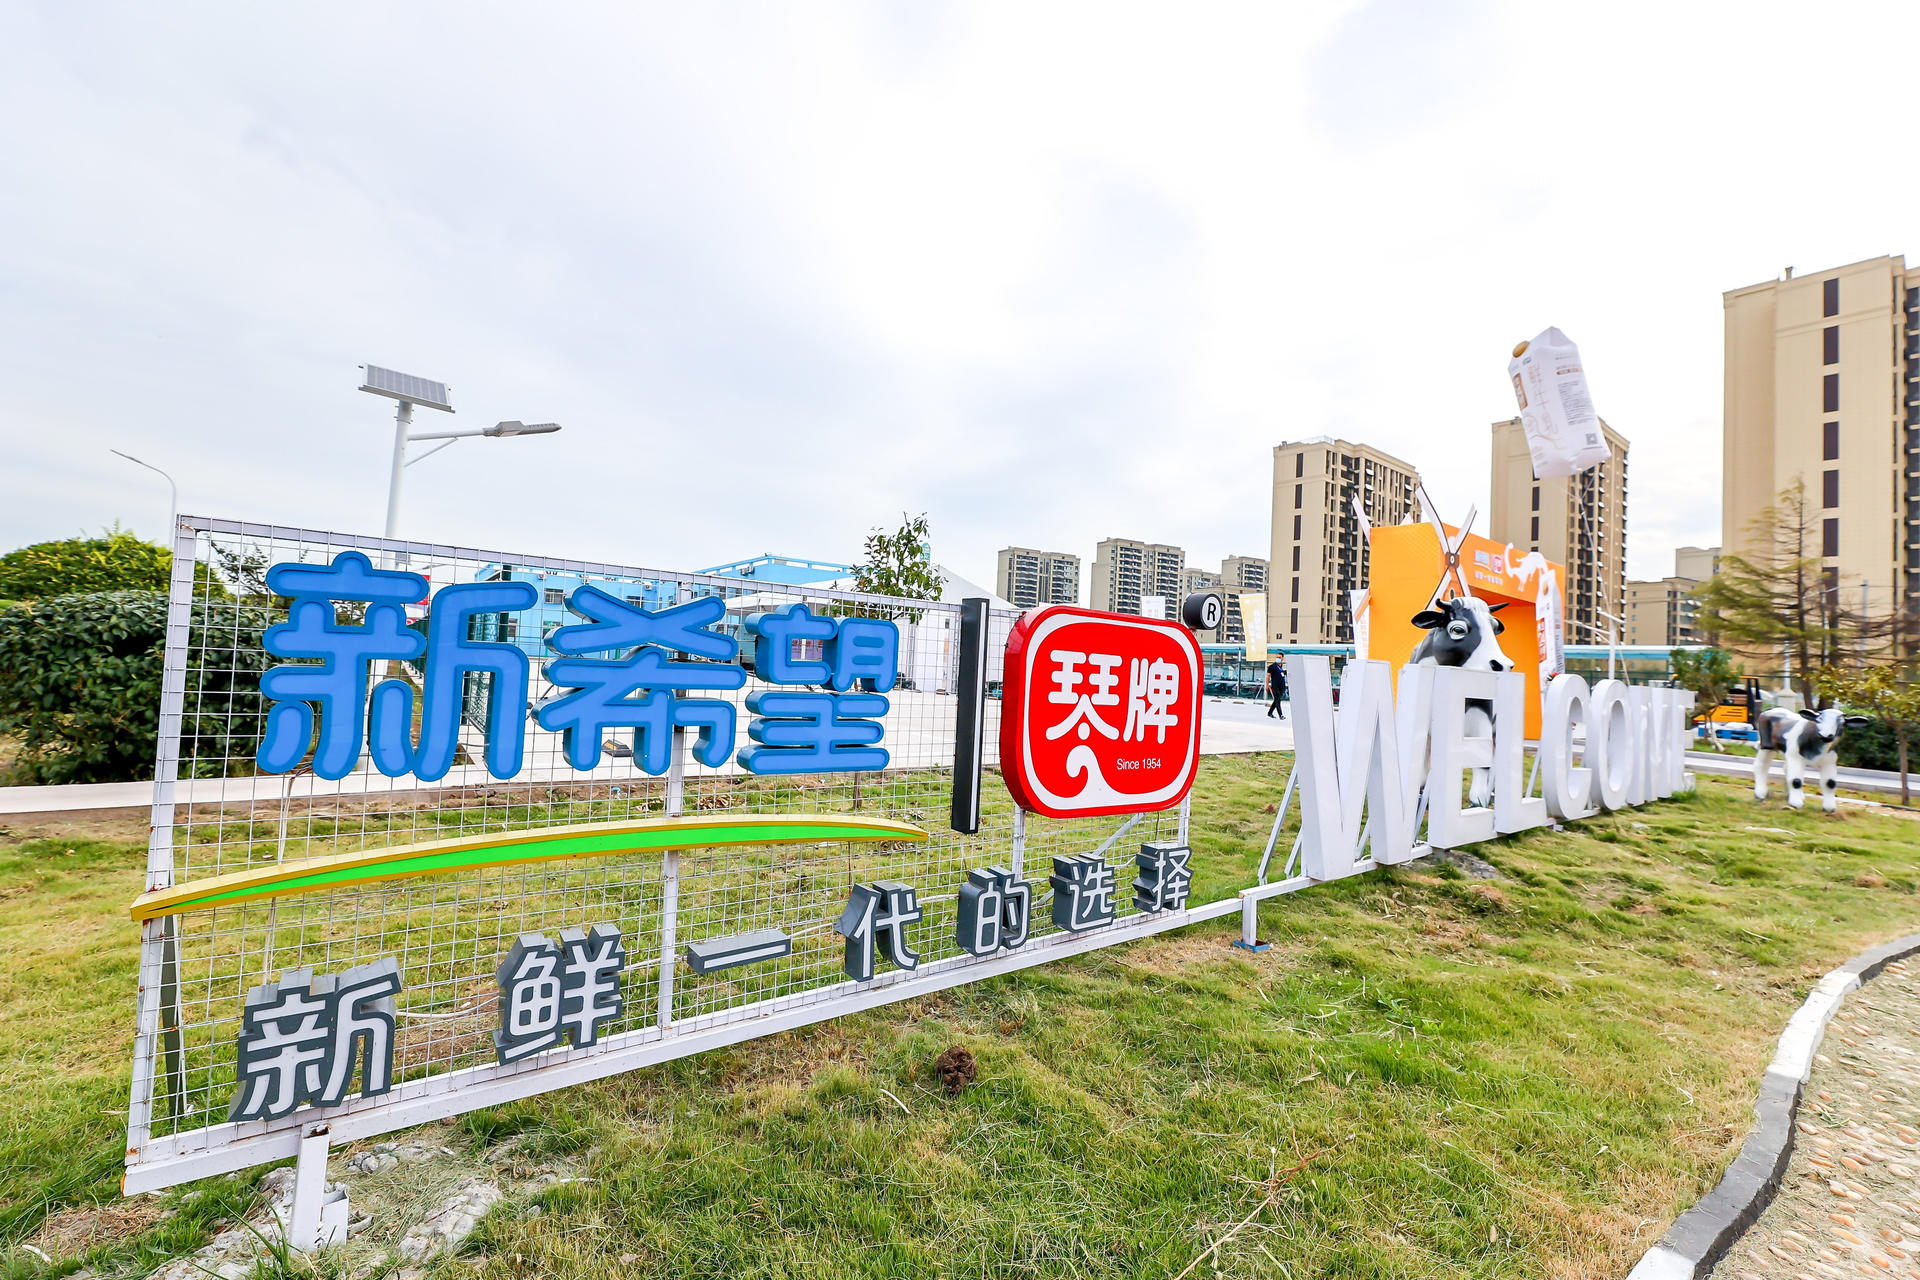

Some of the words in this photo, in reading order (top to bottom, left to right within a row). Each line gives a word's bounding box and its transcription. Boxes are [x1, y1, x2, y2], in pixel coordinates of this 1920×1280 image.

[257, 551, 901, 783] 新希望
[1045, 649, 1180, 745] 琴牌
[1116, 758, 1140, 770] Since
[1142, 757, 1161, 769] 1954
[1287, 654, 1697, 882] WELCOME
[228, 842, 1193, 1122] 新鲜一代的选择
